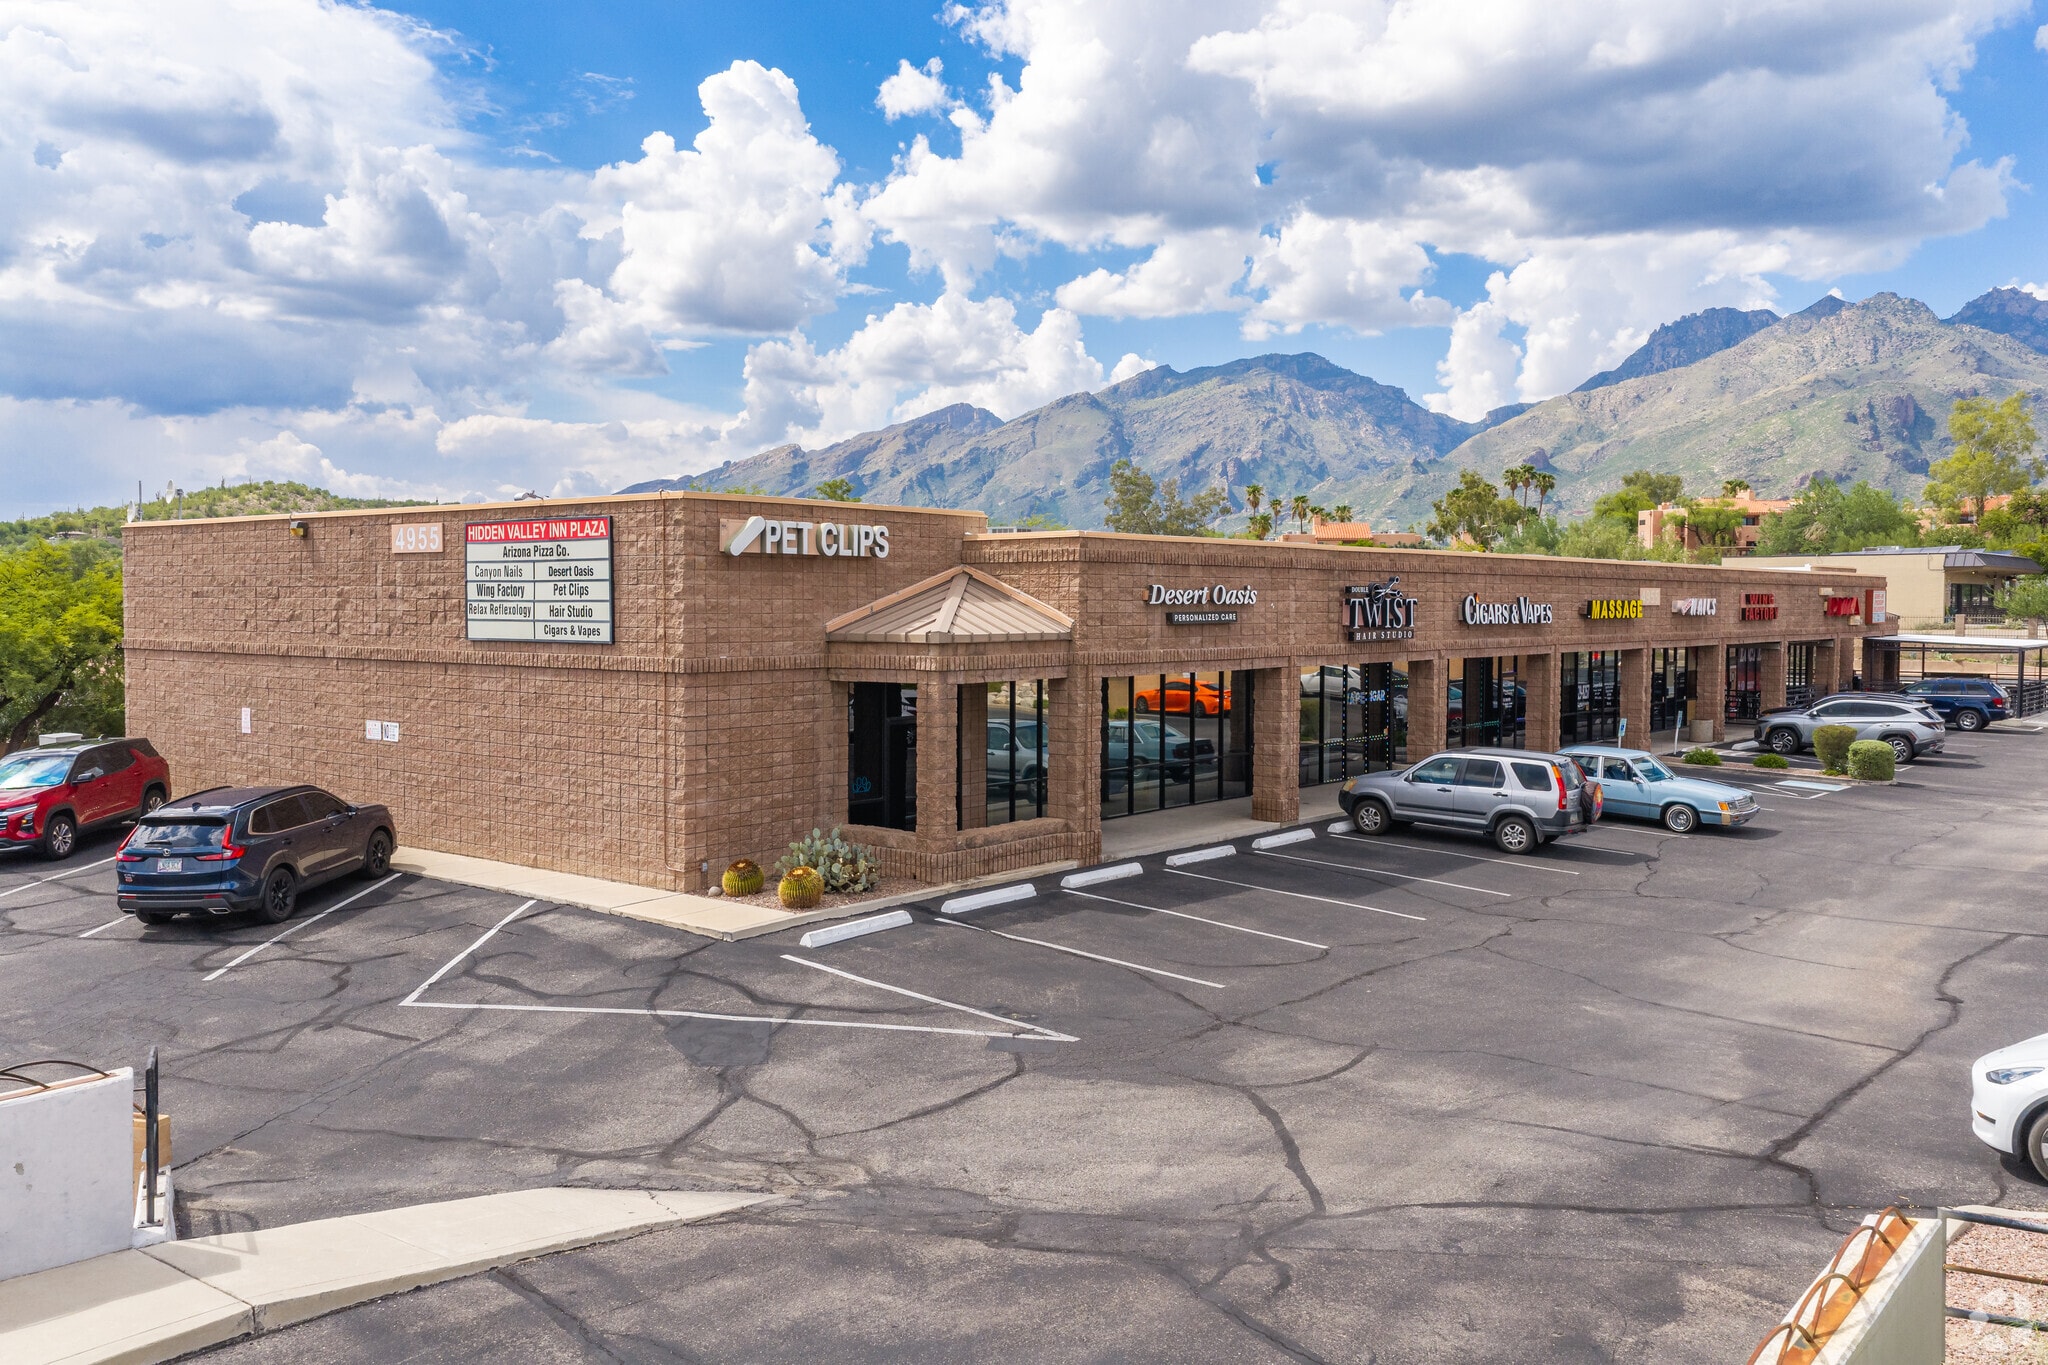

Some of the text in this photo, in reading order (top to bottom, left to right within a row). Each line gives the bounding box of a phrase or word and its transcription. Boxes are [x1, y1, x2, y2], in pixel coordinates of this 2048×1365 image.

[395, 526, 439, 550] 4955
[467, 520, 606, 541] HIDDEN VALLEY INN PLAZA
[764, 519, 889, 558] PET CLIPS
[502, 545, 570, 558] Arizona Pizza Co.
[475, 563, 522, 579] Canyon Nails
[548, 565, 594, 577] Desert Oasis
[476, 583, 525, 598] Wing Factory
[553, 583, 589, 598] Pet Clips
[1149, 584, 1257, 605] Desert Oasis
[1749, 593, 1775, 605] WING
[468, 603, 532, 618] Relax Reflexology
[549, 604, 593, 618] Hair Studio
[1350, 597, 1418, 629] TWIST
[1465, 595, 1553, 625] CIGARS & VAPES
[1591, 599, 1643, 619] MASSAGE
[1690, 598, 1716, 616] NAILS
[1745, 607, 1778, 620] FACTORY
[1174, 613, 1219, 621] PERSONALIZED
[543, 624, 601, 638] Cigars & Vapes
[1356, 630, 1412, 640] HAIR STUDIO
